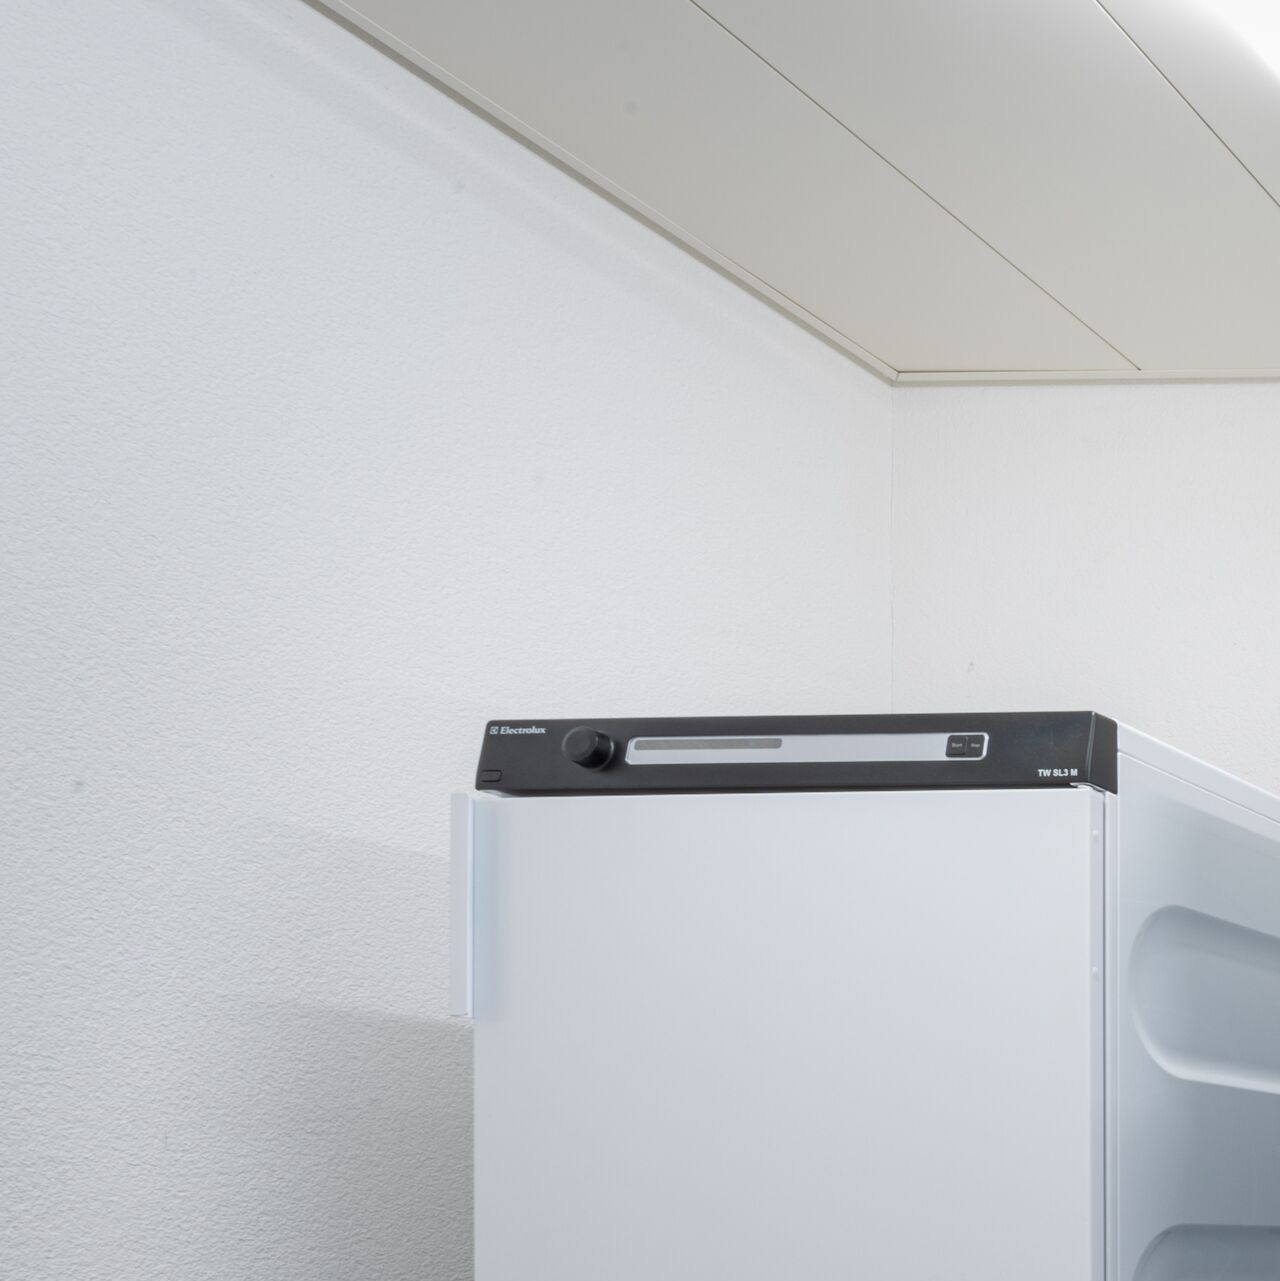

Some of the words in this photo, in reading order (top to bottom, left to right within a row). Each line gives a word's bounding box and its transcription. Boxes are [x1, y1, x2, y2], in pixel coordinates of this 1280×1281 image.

[500, 725, 546, 734] Electrolux
[1037, 769, 1051, 777] TW
[1053, 768, 1069, 777] SL3
[1070, 768, 1078, 776] M
